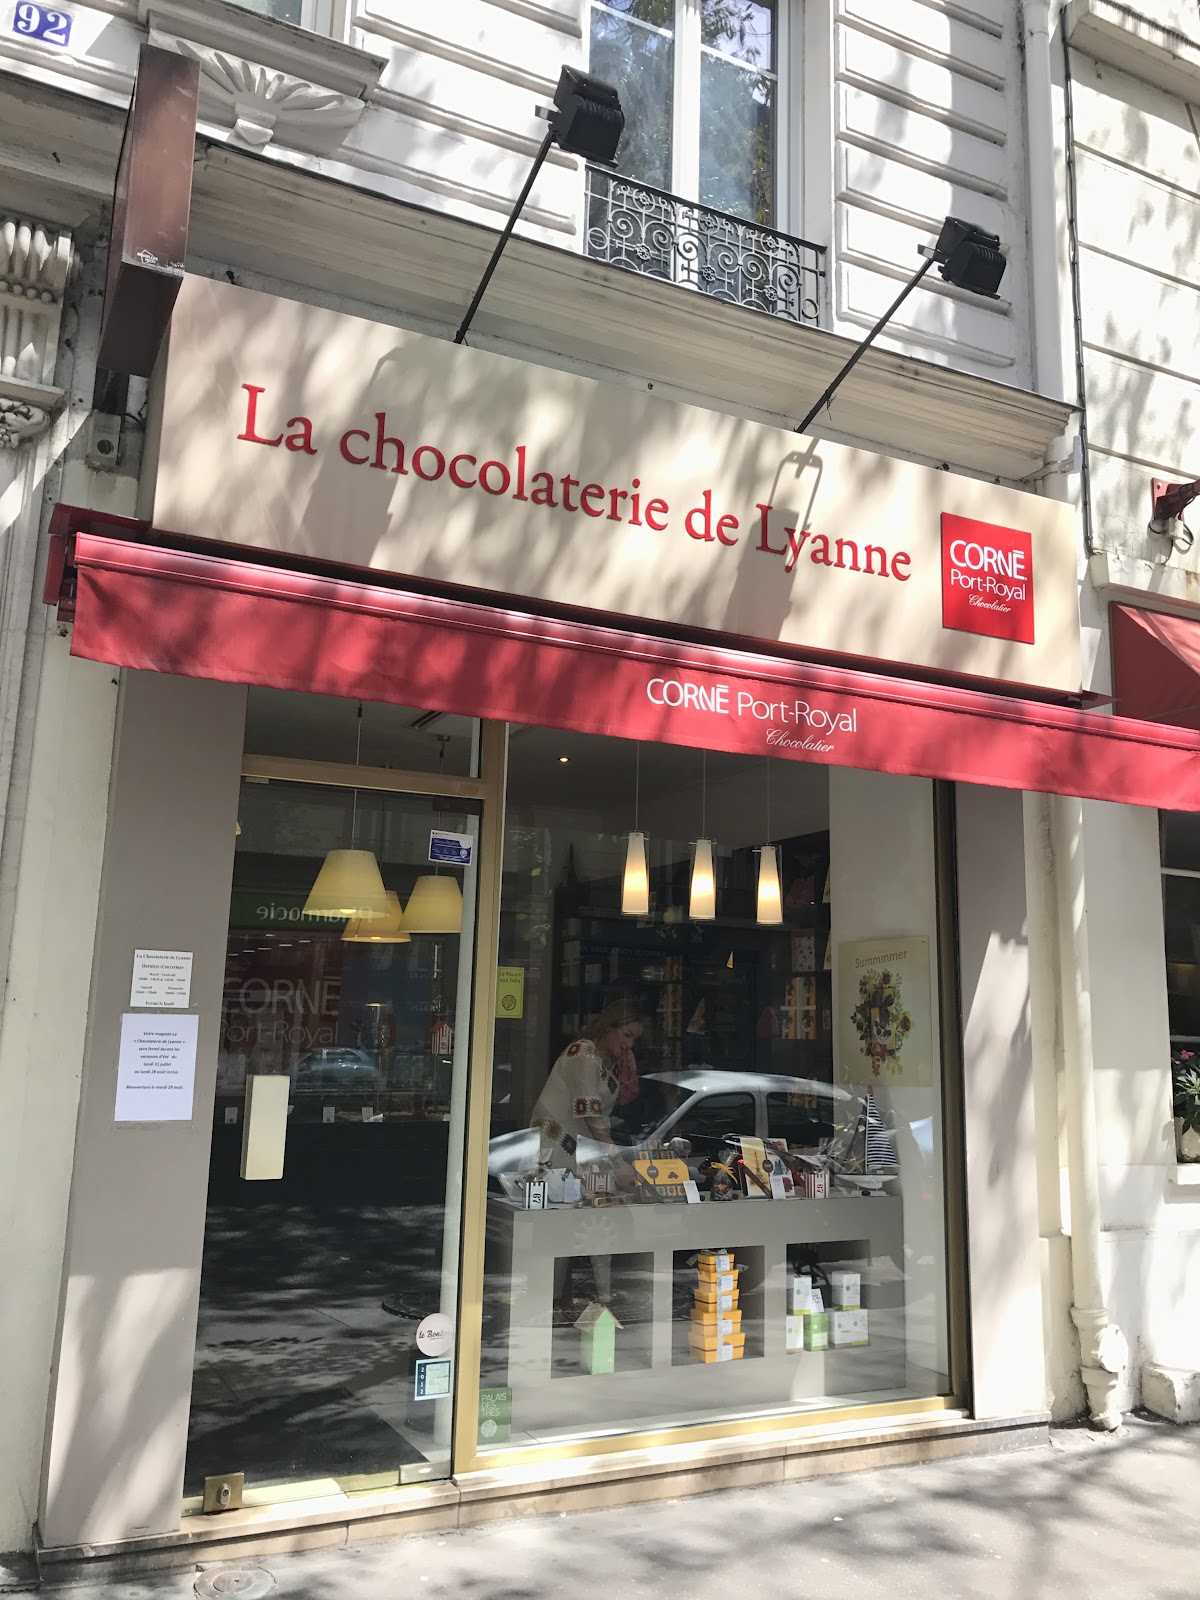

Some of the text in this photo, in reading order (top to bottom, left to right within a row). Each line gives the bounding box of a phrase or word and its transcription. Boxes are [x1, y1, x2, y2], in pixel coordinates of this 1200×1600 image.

[17, 4, 68, 44] 92
[237, 383, 913, 582] La chocolaterie de Lyanne
[951, 568, 1026, 602] Port-Royal
[968, 593, 1012, 613] Chocolatier
[737, 691, 857, 736] Port-Royal
[766, 728, 836, 753] Chocolatier
[481, 1392, 507, 1403] PALAIS
[481, 1401, 497, 1411] DES
